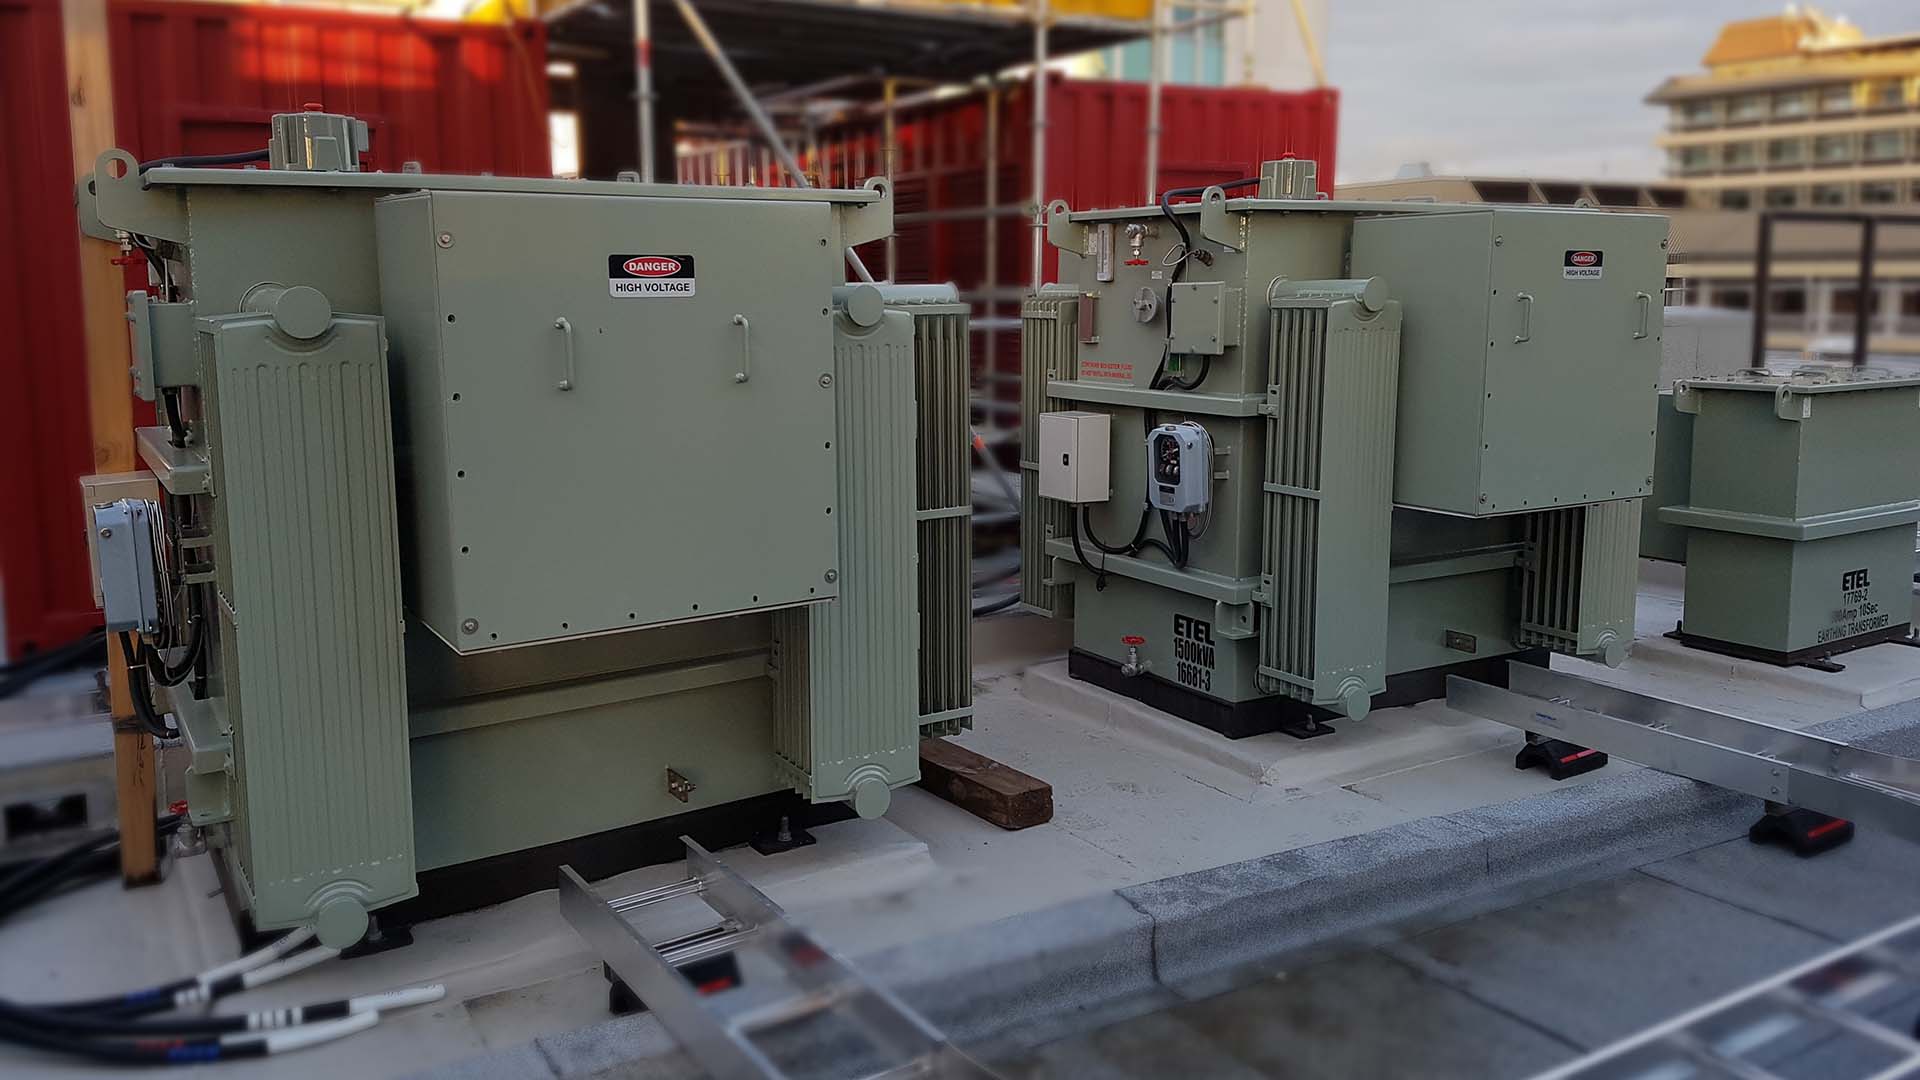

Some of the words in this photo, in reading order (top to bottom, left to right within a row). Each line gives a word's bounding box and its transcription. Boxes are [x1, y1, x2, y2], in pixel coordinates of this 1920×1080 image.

[629, 262, 676, 271] DANGER
[616, 283, 642, 292] HIGH
[644, 283, 690, 292] VOLTAGE
[1842, 568, 1870, 591] ETEL
[1858, 602, 1878, 617] 10Sec
[1174, 613, 1216, 646] ETEL
[1817, 624, 1846, 643] EARTHING
[1848, 614, 1889, 636] TRANSFORMER
[1173, 637, 1215, 670] 1500kVA
[1176, 661, 1211, 692] 16681-3
